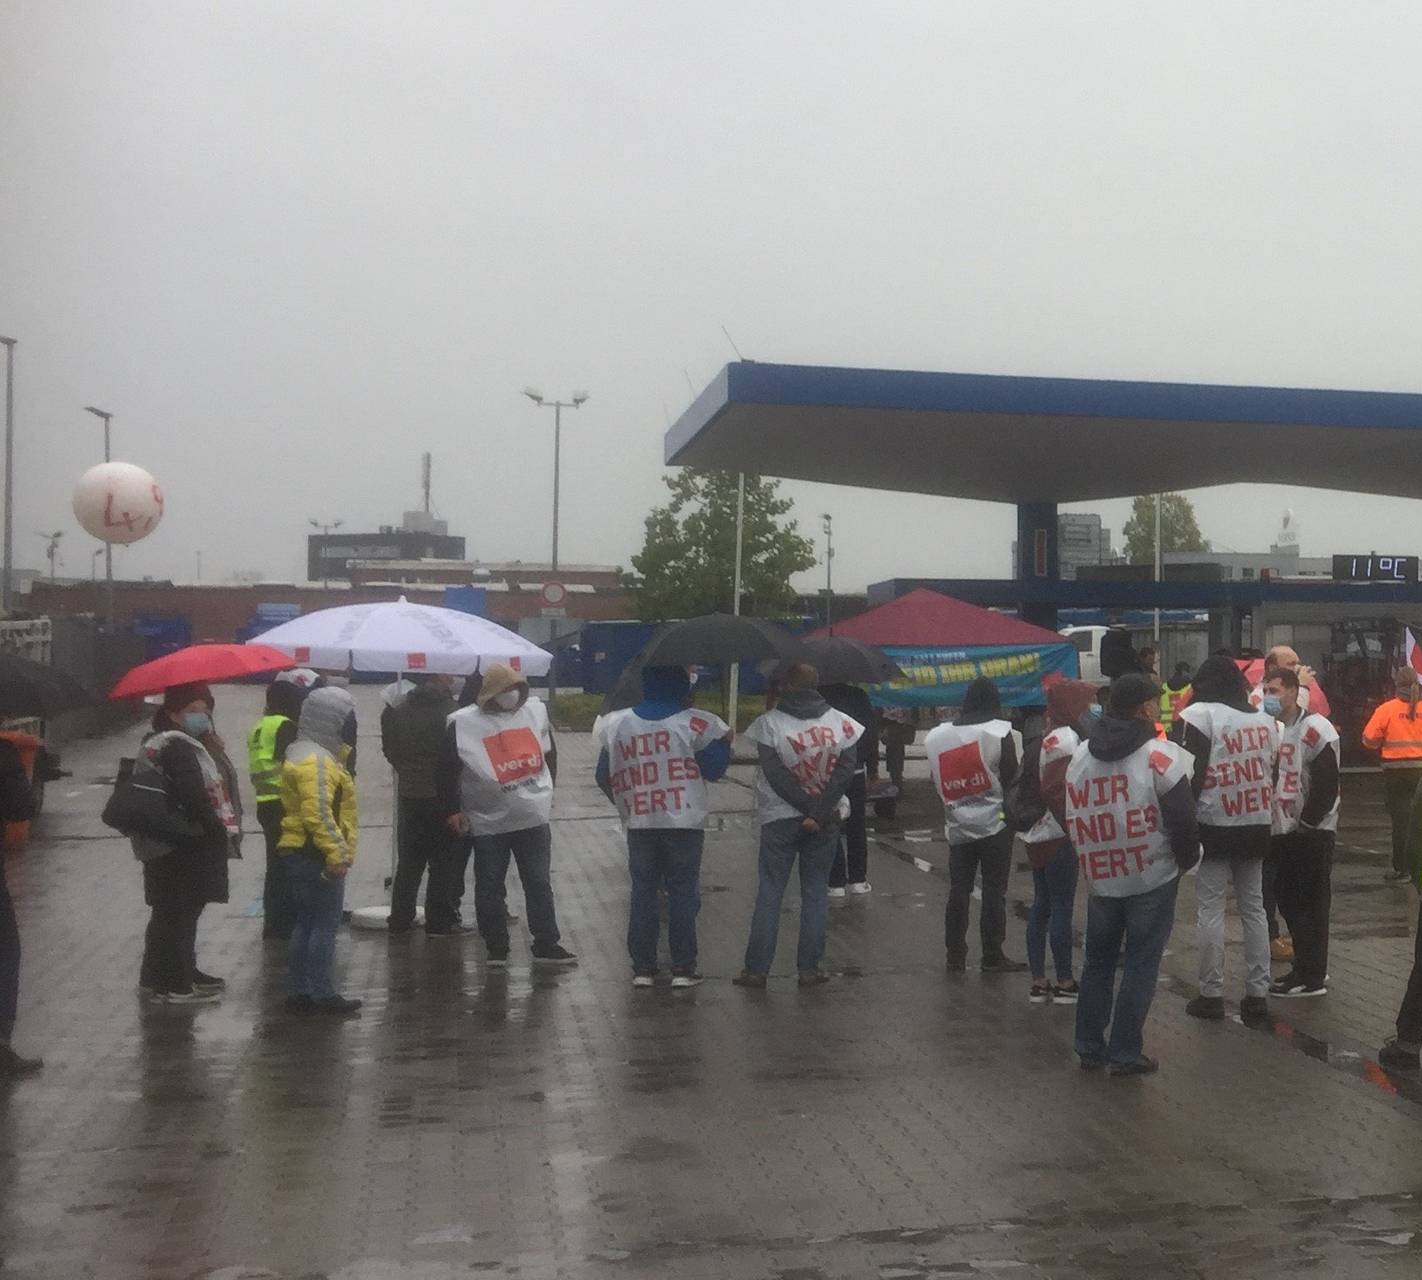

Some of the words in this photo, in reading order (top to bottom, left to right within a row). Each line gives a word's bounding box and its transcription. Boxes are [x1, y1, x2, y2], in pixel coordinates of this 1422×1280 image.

[619, 729, 671, 761] WIR
[667, 756, 700, 781] ES
[623, 787, 691, 816] ERT.
[1067, 774, 1130, 809] WIR
[1222, 784, 1274, 817] WER
[1079, 844, 1154, 880] ERT.
